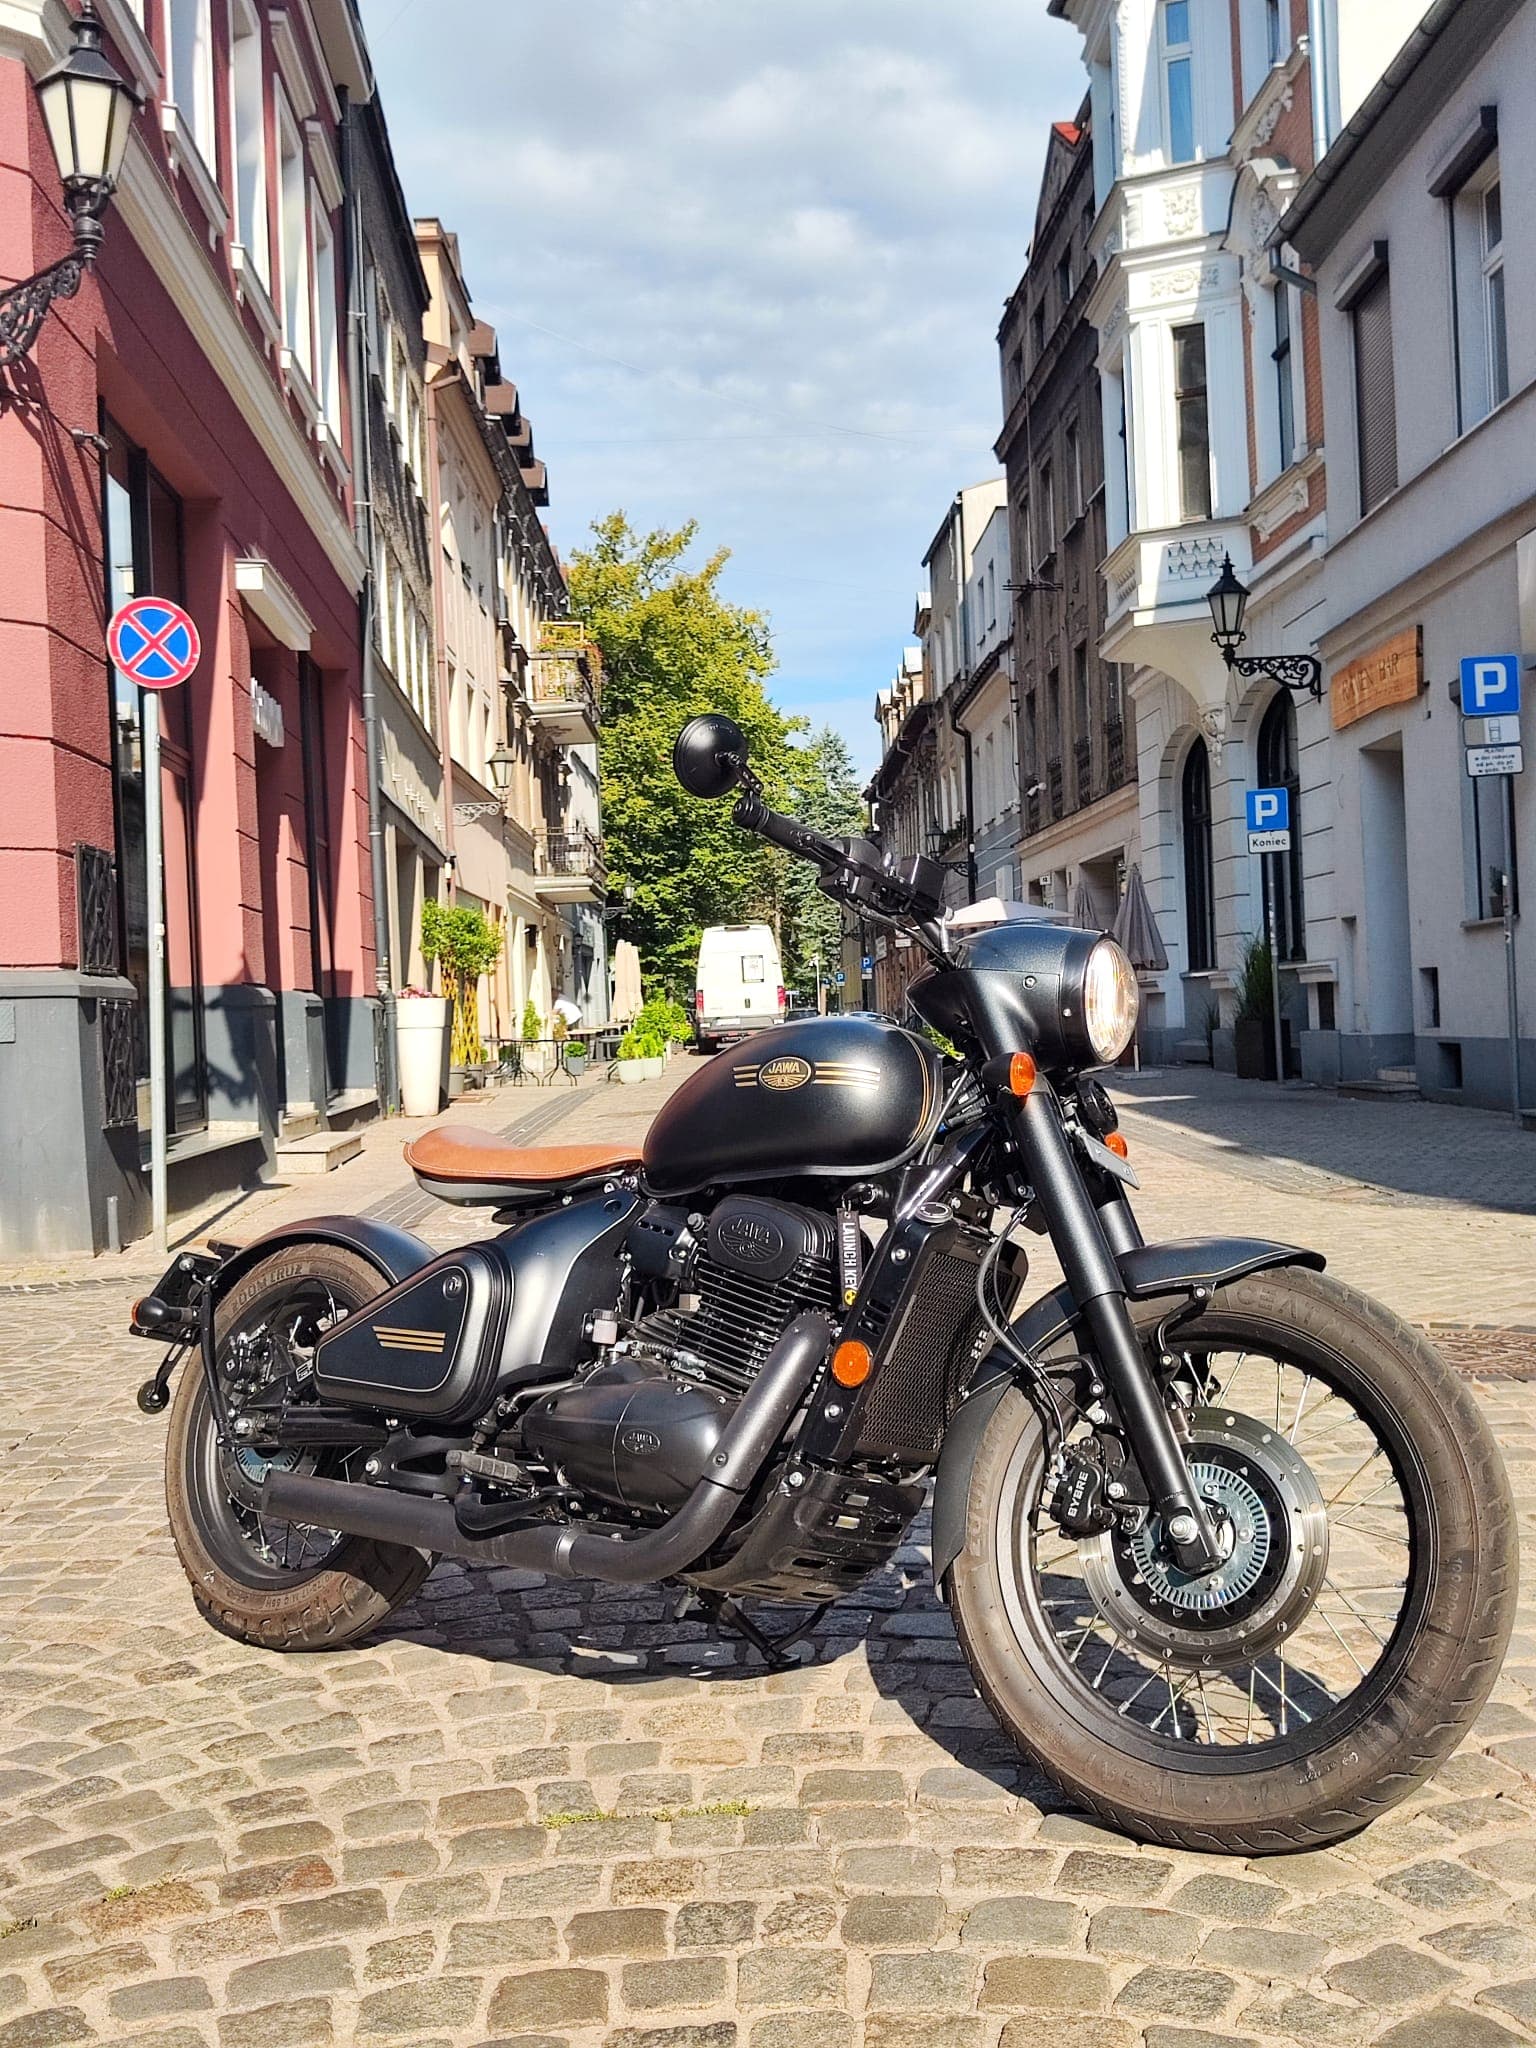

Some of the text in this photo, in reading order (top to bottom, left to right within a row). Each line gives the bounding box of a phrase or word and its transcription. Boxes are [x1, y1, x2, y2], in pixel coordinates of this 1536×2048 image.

[1474, 662, 1507, 708] P
[1255, 794, 1279, 826] P
[1252, 837, 1287, 848] Koniec
[863, 957, 871, 968] P
[837, 973, 844, 981] P
[768, 1061, 801, 1074] JAWA
[731, 1218, 770, 1244] JAWA
[842, 1222, 858, 1292] LAUNCH KEY
[1067, 1471, 1089, 1518] BYBRE
